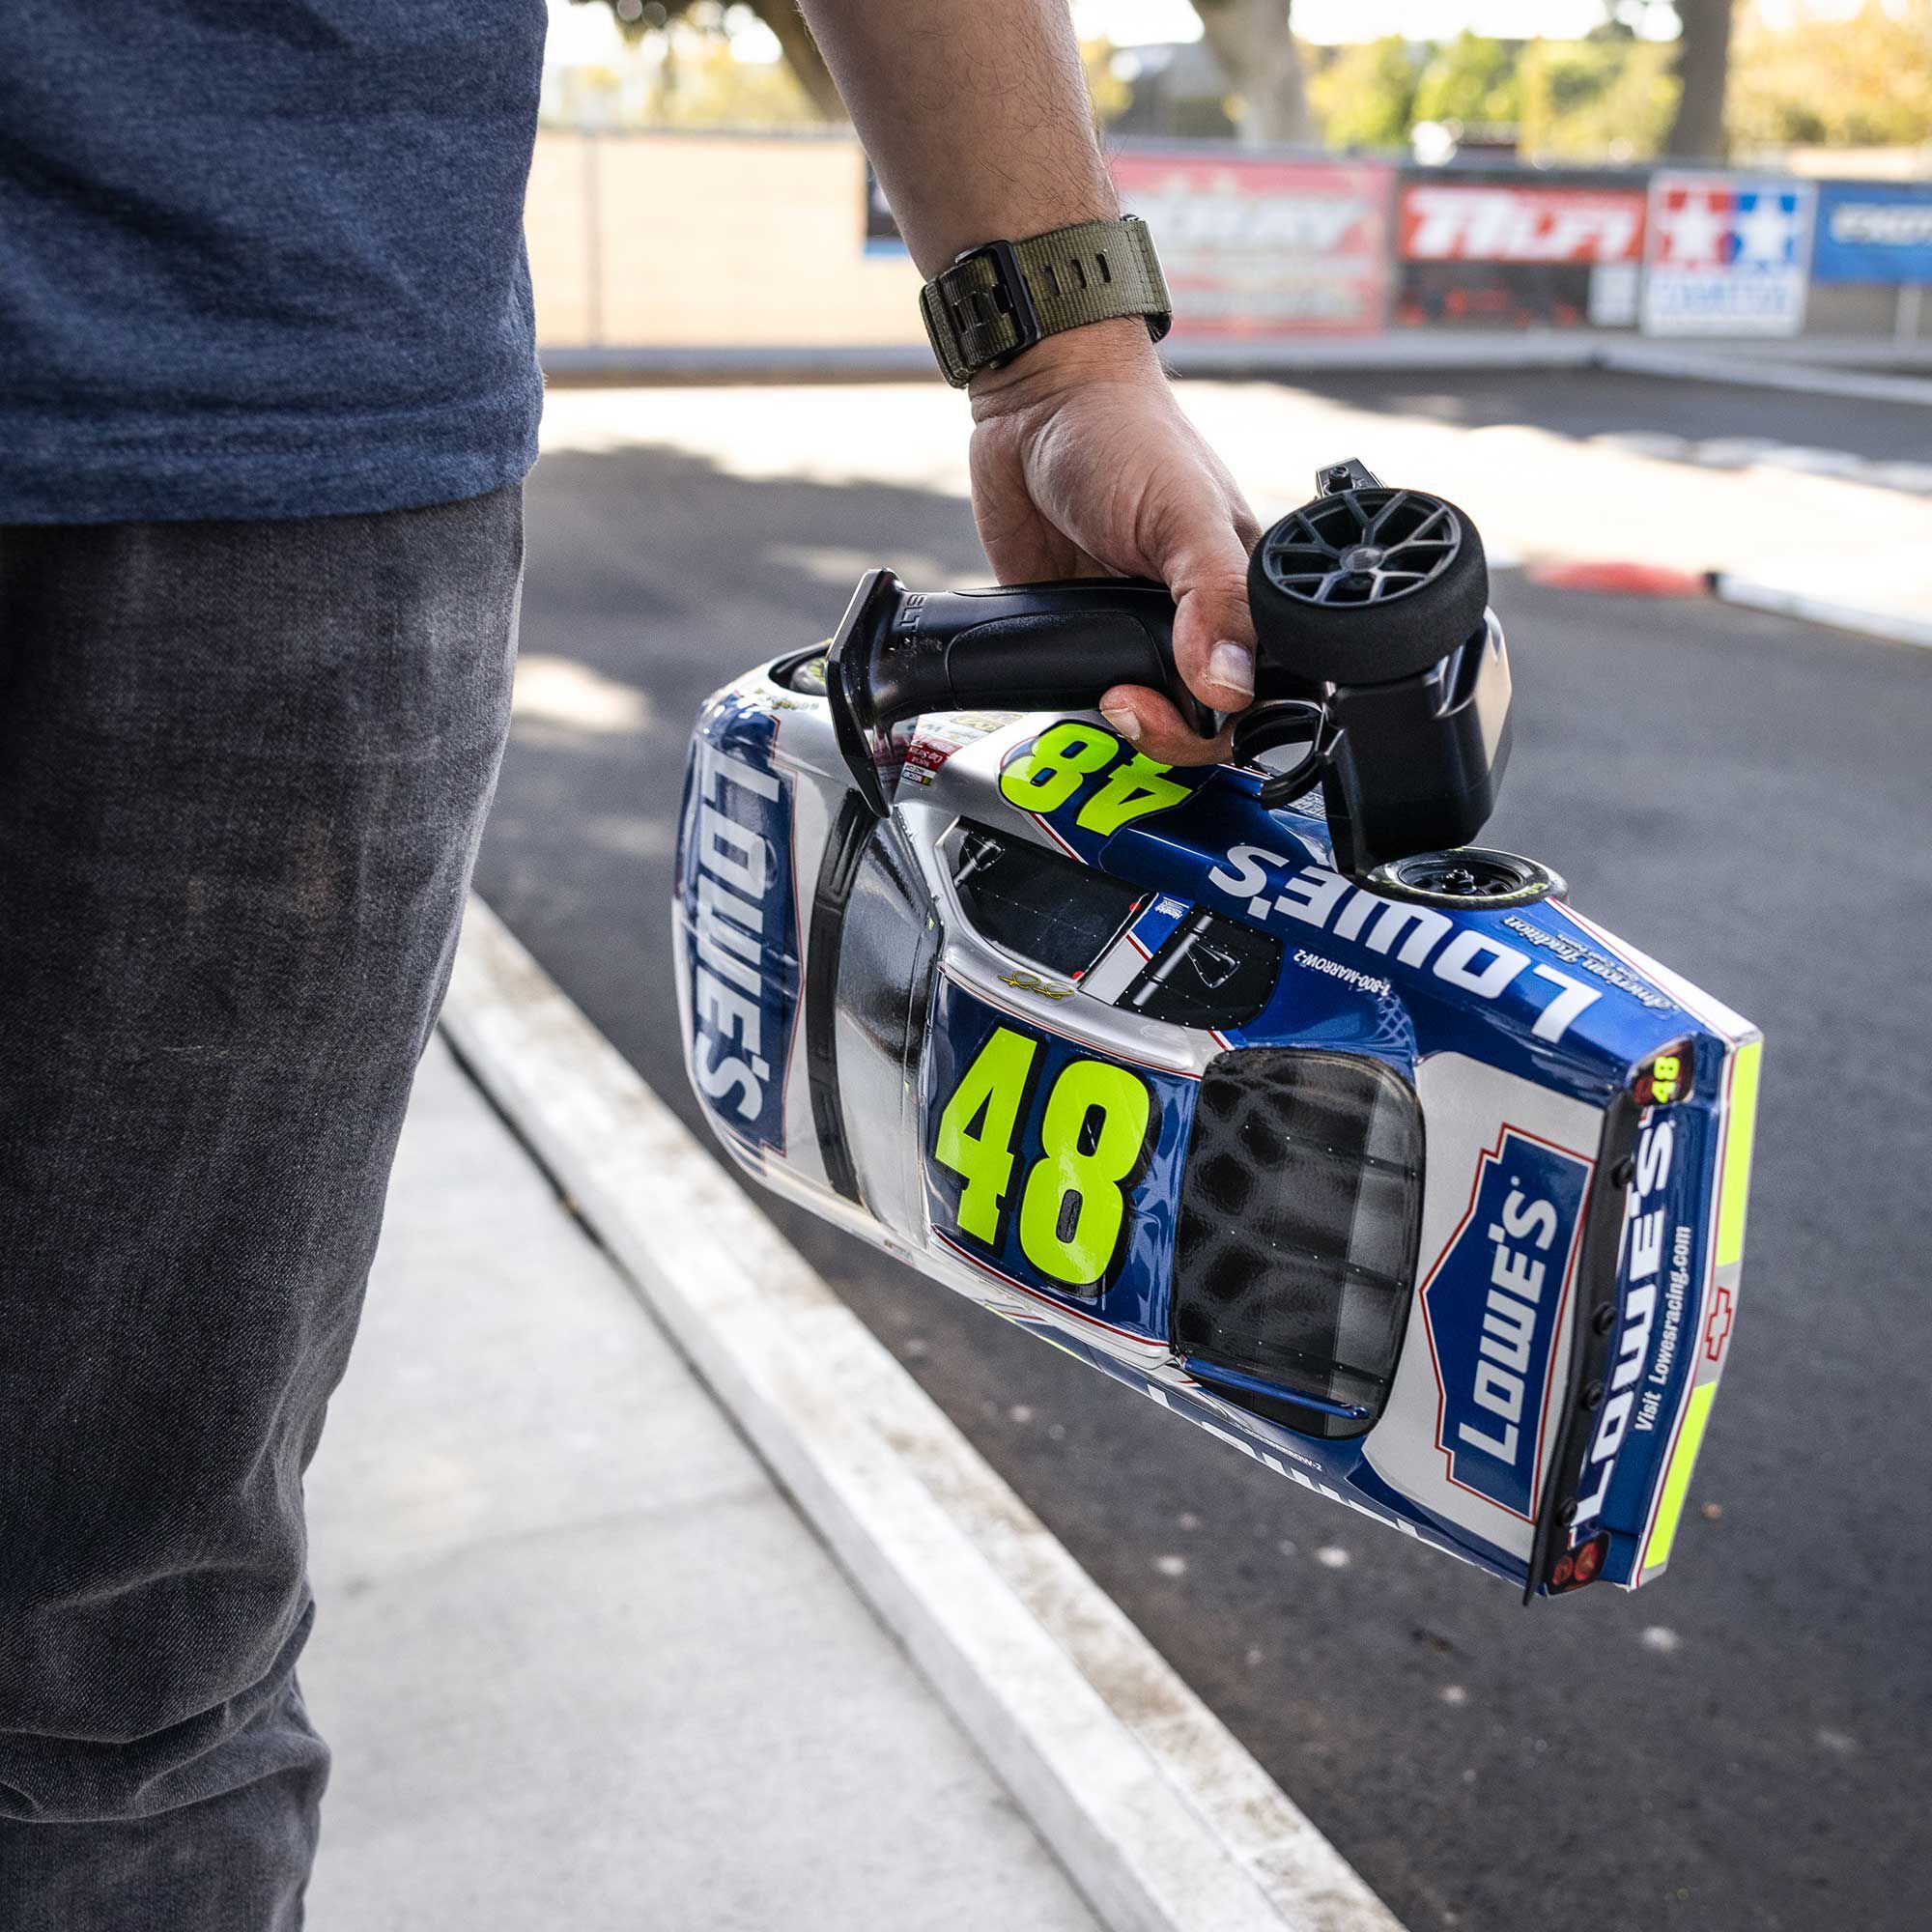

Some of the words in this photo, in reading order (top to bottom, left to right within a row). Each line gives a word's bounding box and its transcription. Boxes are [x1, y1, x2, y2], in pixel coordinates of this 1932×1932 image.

[1000, 723, 1193, 837] 48
[696, 746, 780, 1122] LOWE'S
[1208, 844, 1604, 1044] LOWE'S
[935, 1026, 1151, 1285] 48
[1651, 1056, 1681, 1104] 48
[1458, 1189, 1558, 1466] LOWE'S
[1570, 1121, 1674, 1527] LOWE'S
[1634, 1391, 1662, 1432] Visit
[1648, 1225, 1692, 1385] Lowesracing.com
